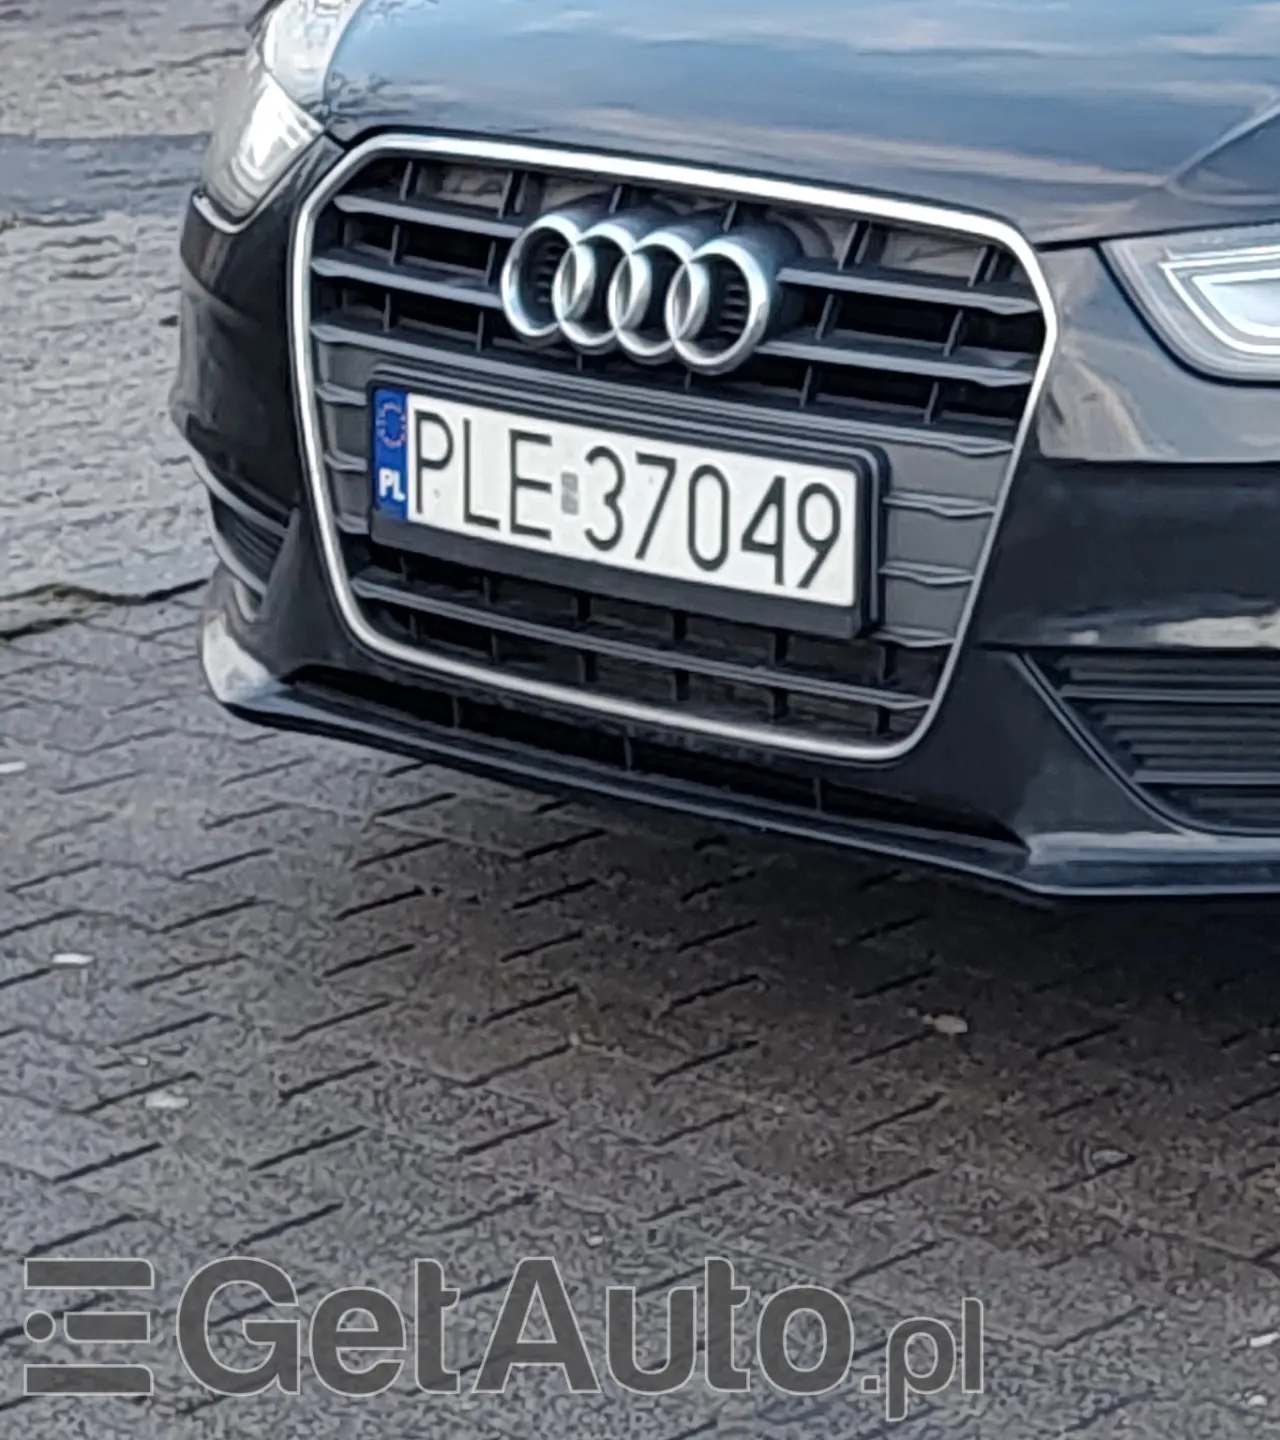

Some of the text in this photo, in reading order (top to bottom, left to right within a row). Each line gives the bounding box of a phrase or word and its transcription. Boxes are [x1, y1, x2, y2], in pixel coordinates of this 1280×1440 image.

[379, 467, 406, 502] PL
[414, 409, 842, 589] PLE 37049
